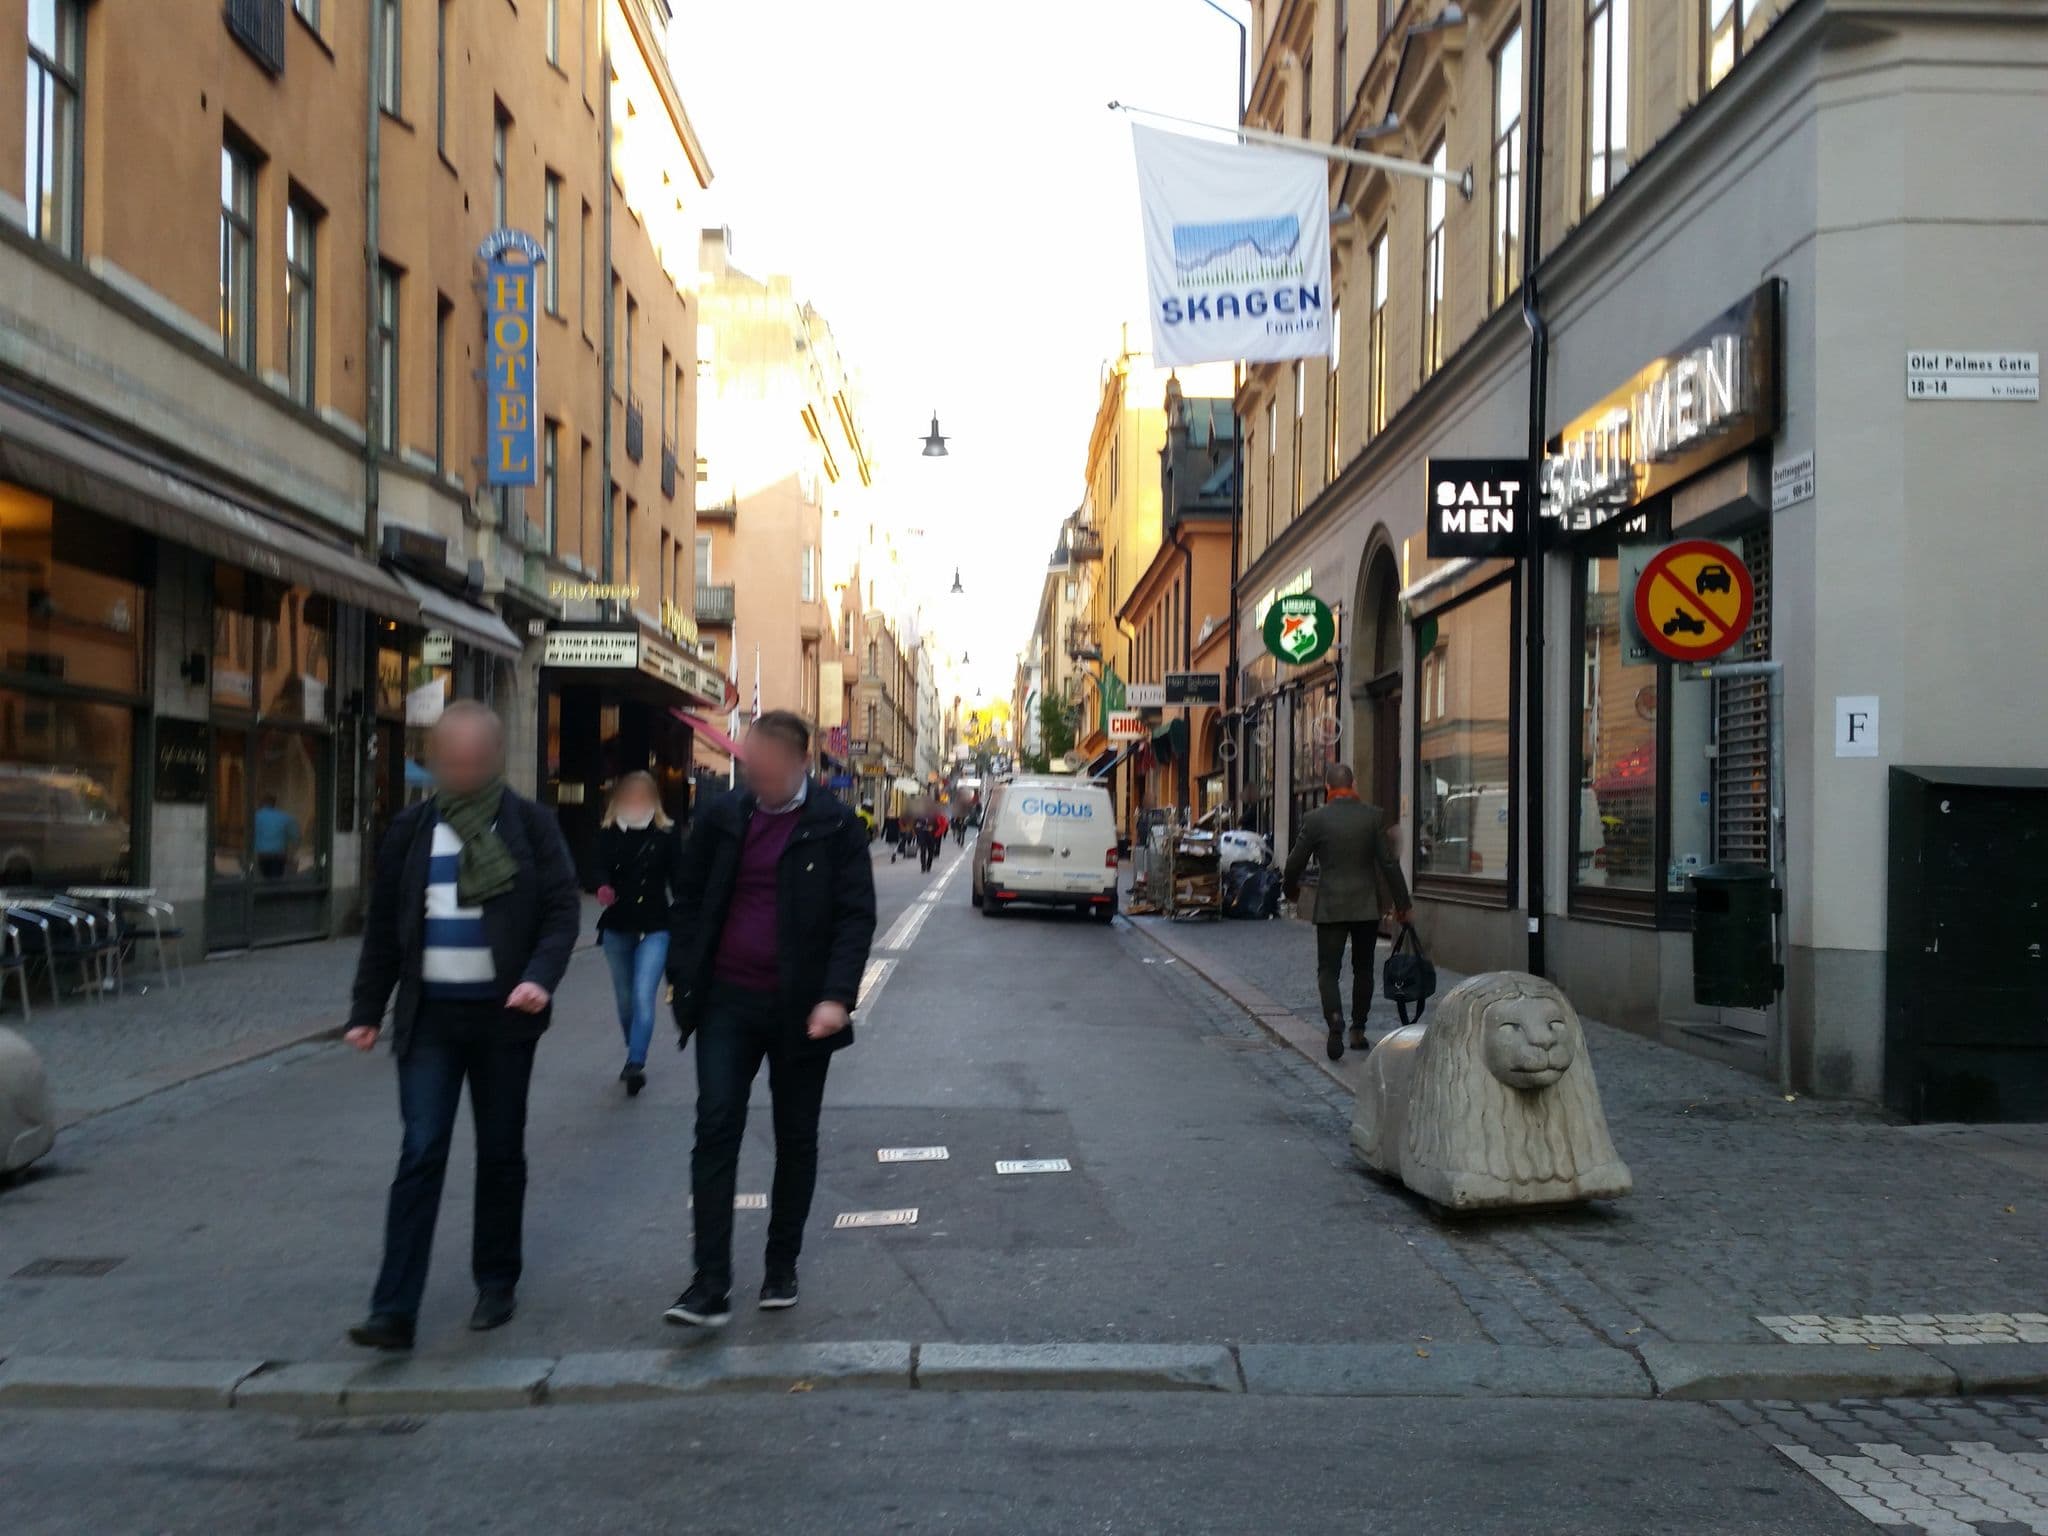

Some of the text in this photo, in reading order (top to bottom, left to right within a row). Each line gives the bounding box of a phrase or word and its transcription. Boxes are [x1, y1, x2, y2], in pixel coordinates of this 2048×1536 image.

[1162, 284, 1321, 325] SKAGEN
[493, 274, 530, 472] HOTEL
[1911, 356, 2032, 371] Olaf Palmes Gata
[1632, 335, 1738, 464] MEN
[1911, 379, 1948, 394] 18-14
[1437, 480, 1520, 506] SALT
[1442, 508, 1514, 534] MEN
[549, 581, 640, 602] Playhouse
[1847, 712, 1868, 743] F
[1022, 797, 1093, 818] Globus
